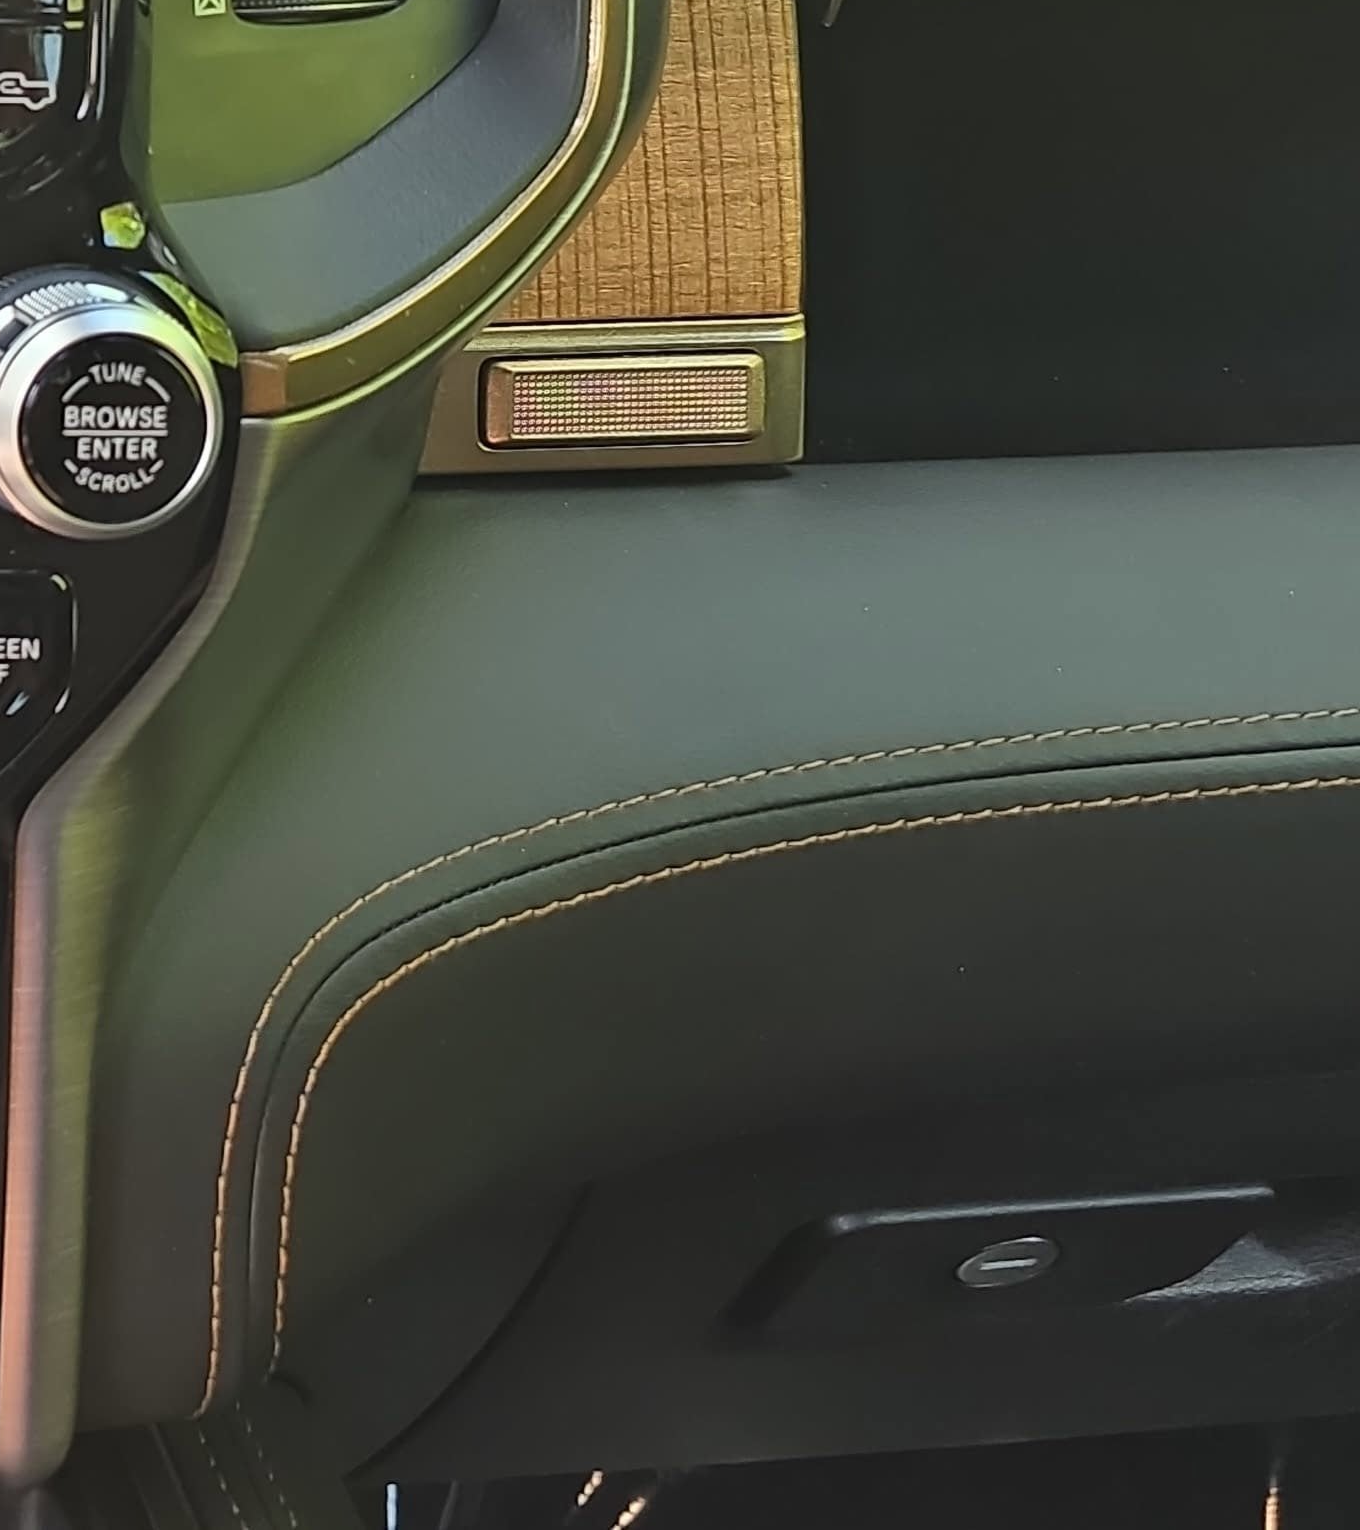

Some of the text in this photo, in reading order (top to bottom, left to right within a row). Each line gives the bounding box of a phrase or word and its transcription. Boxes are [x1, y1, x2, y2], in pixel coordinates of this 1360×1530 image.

[88, 362, 147, 386] TUNE
[64, 405, 168, 430] BROWSE
[77, 437, 158, 461] ENTER
[75, 466, 155, 494] SCROLL
